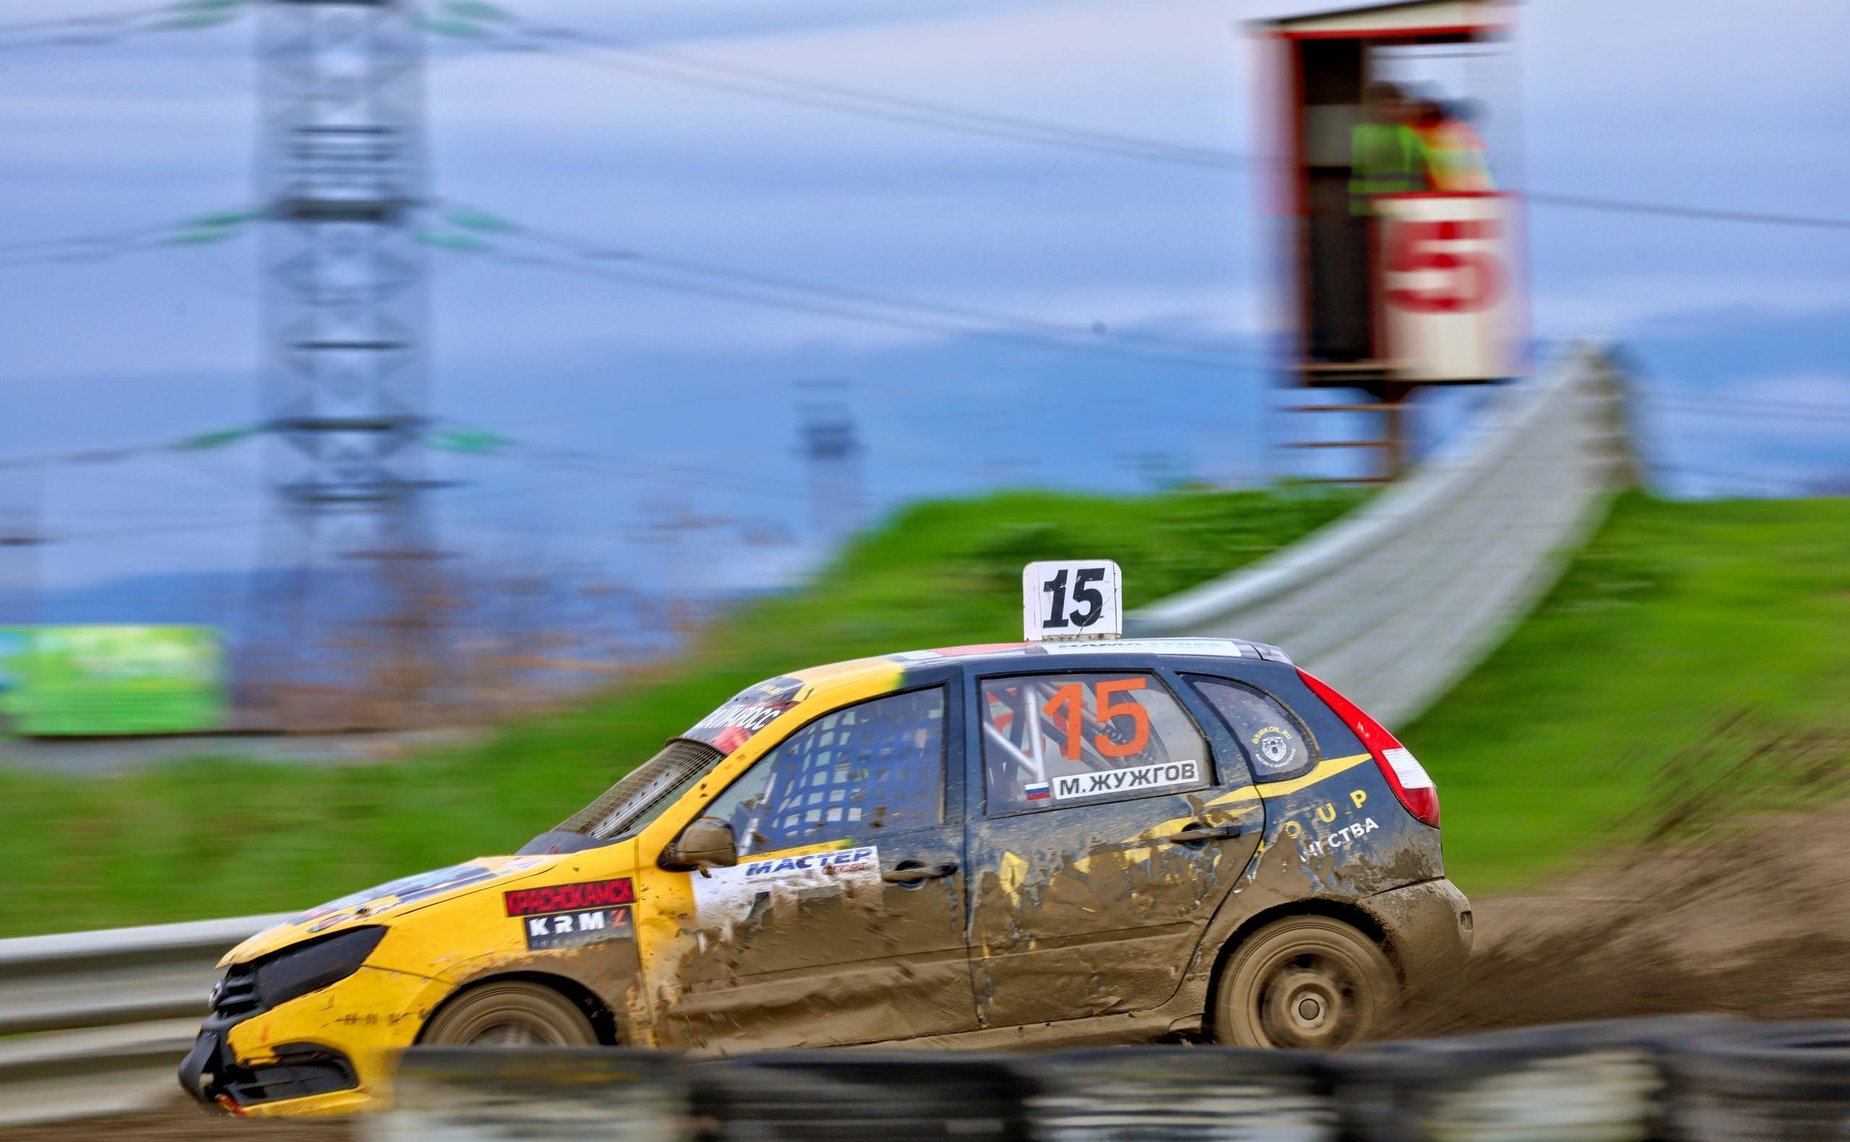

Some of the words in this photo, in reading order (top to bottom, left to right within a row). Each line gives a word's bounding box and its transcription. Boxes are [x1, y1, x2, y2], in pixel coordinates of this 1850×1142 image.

[1379, 219, 1511, 314] 5
[1043, 568, 1106, 629] 15
[1042, 677, 1150, 761] 15
[1059, 763, 1196, 796] М.ЖУЖГОВ
[745, 849, 874, 876] МАСТЕР
